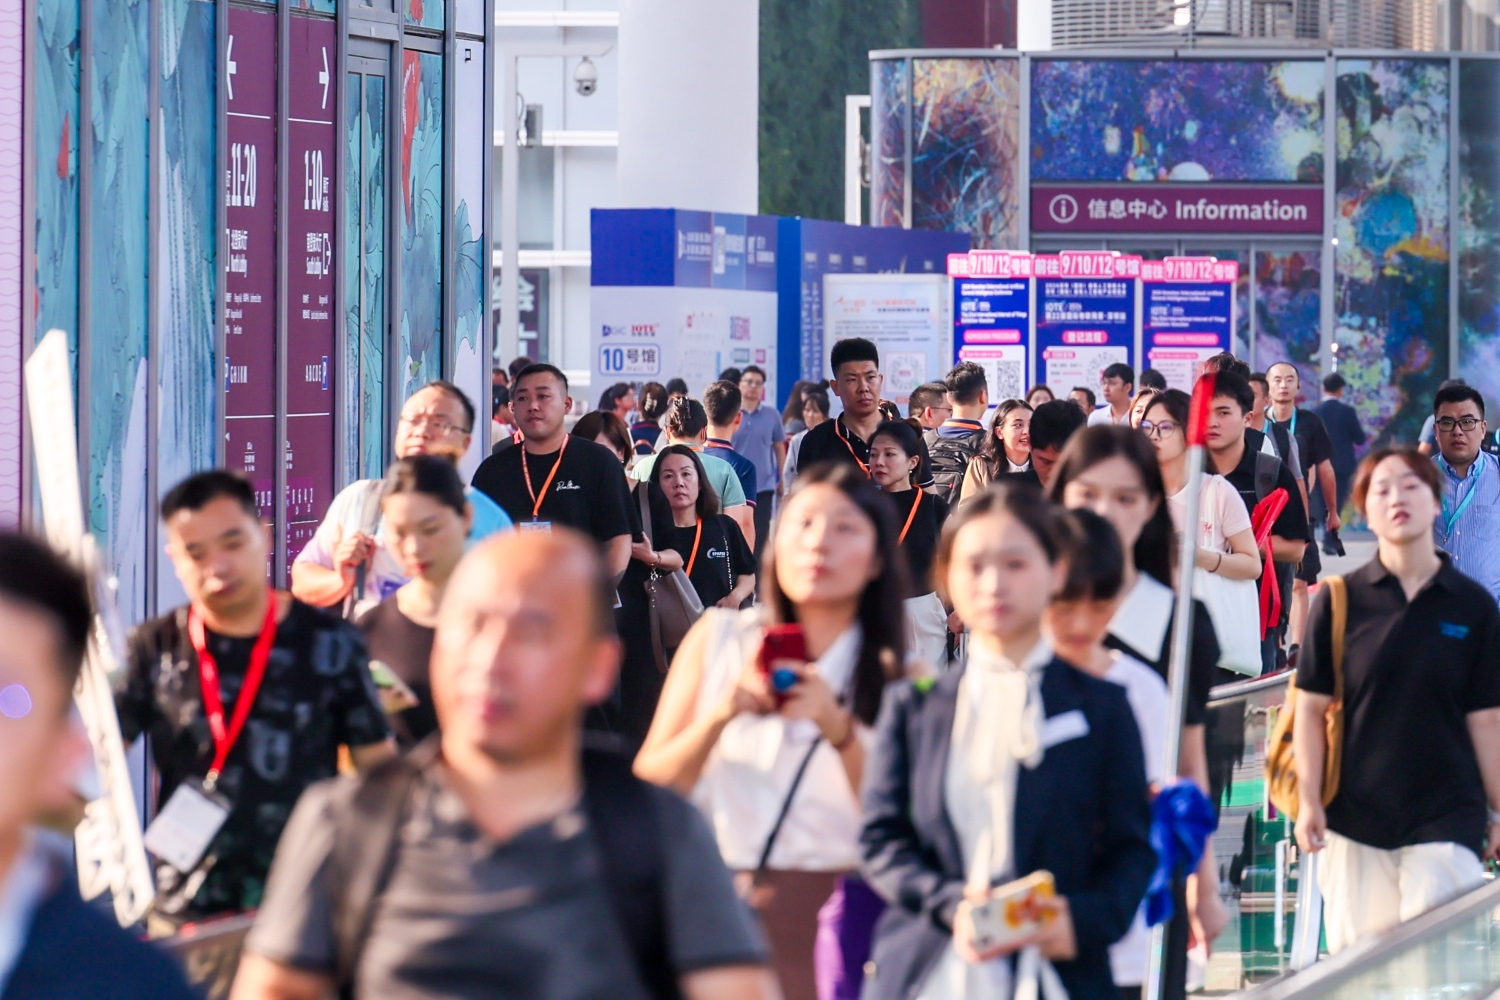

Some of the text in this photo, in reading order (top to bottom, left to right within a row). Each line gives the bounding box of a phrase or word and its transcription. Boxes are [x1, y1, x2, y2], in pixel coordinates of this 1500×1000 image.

[231, 143, 257, 208] 11-20
[304, 150, 323, 211] 1-10
[1088, 198, 1307, 220] 信息中心 Information
[1062, 255, 1112, 275] 9/10/12
[603, 348, 624, 371] 10
